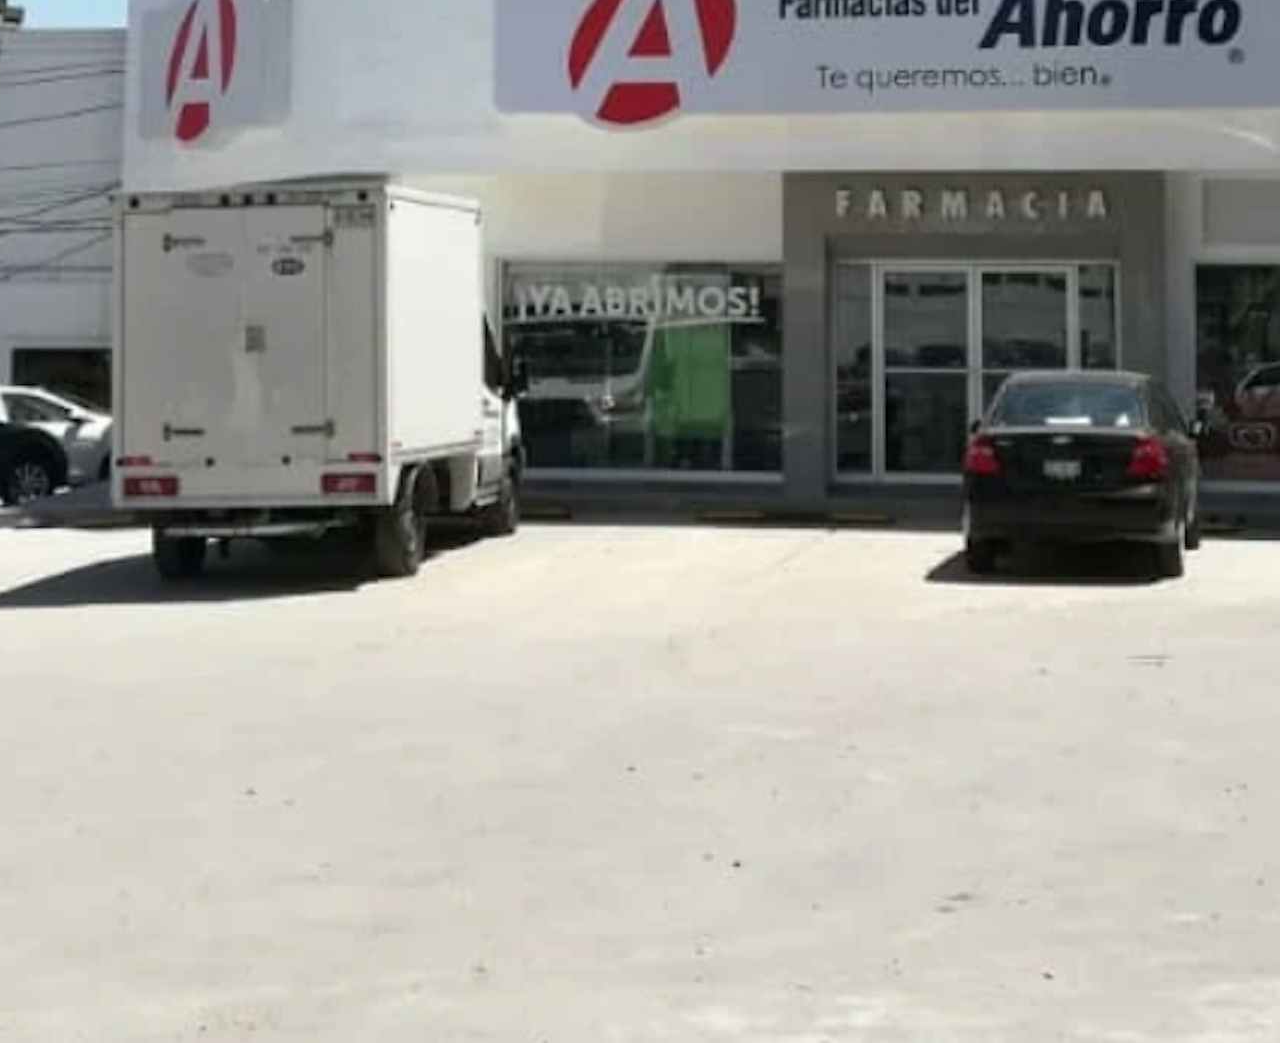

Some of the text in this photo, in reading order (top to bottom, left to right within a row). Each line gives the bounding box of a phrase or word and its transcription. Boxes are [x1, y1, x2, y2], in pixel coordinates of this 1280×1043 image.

[816, 65, 849, 89] Te
[834, 189, 1108, 220] FARMACIA
[580, 286, 761, 317] ABRIMOS!
